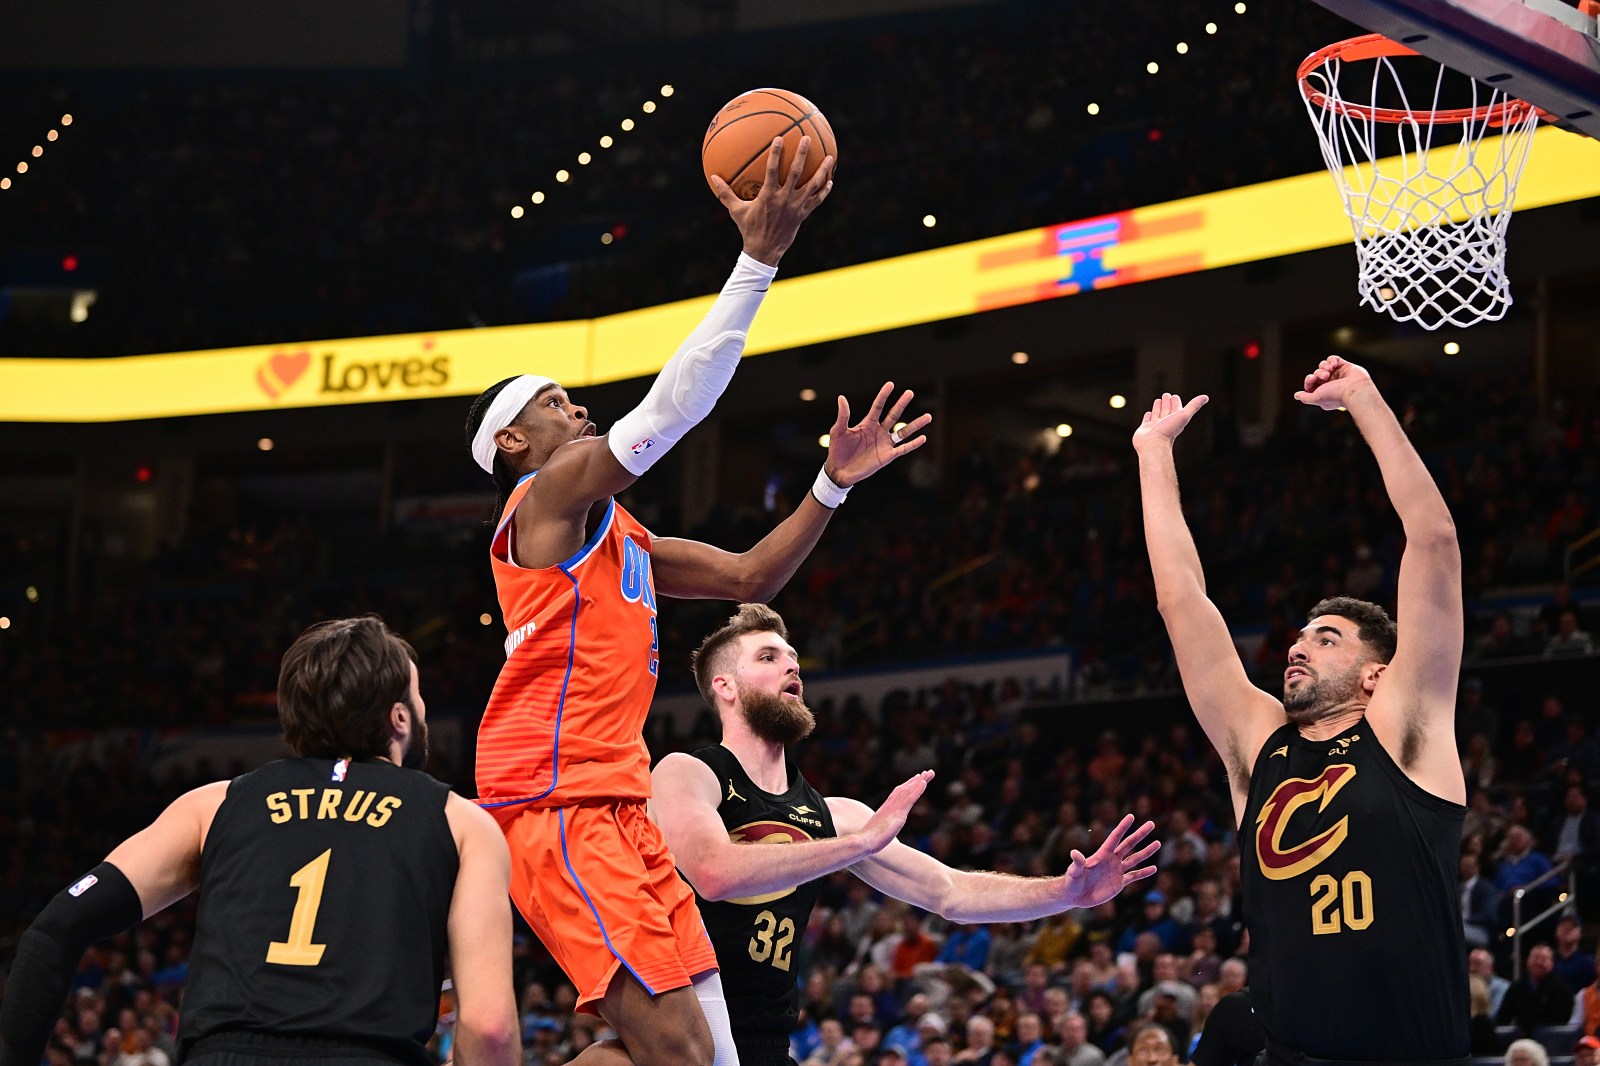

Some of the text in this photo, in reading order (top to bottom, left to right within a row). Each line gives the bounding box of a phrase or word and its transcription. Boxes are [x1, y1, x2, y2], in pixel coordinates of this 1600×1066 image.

[266, 789, 403, 828] STRUS
[788, 813, 822, 828] CLIFFS
[266, 847, 332, 967] 1
[1310, 870, 1375, 936] 20
[748, 909, 796, 972] 32
